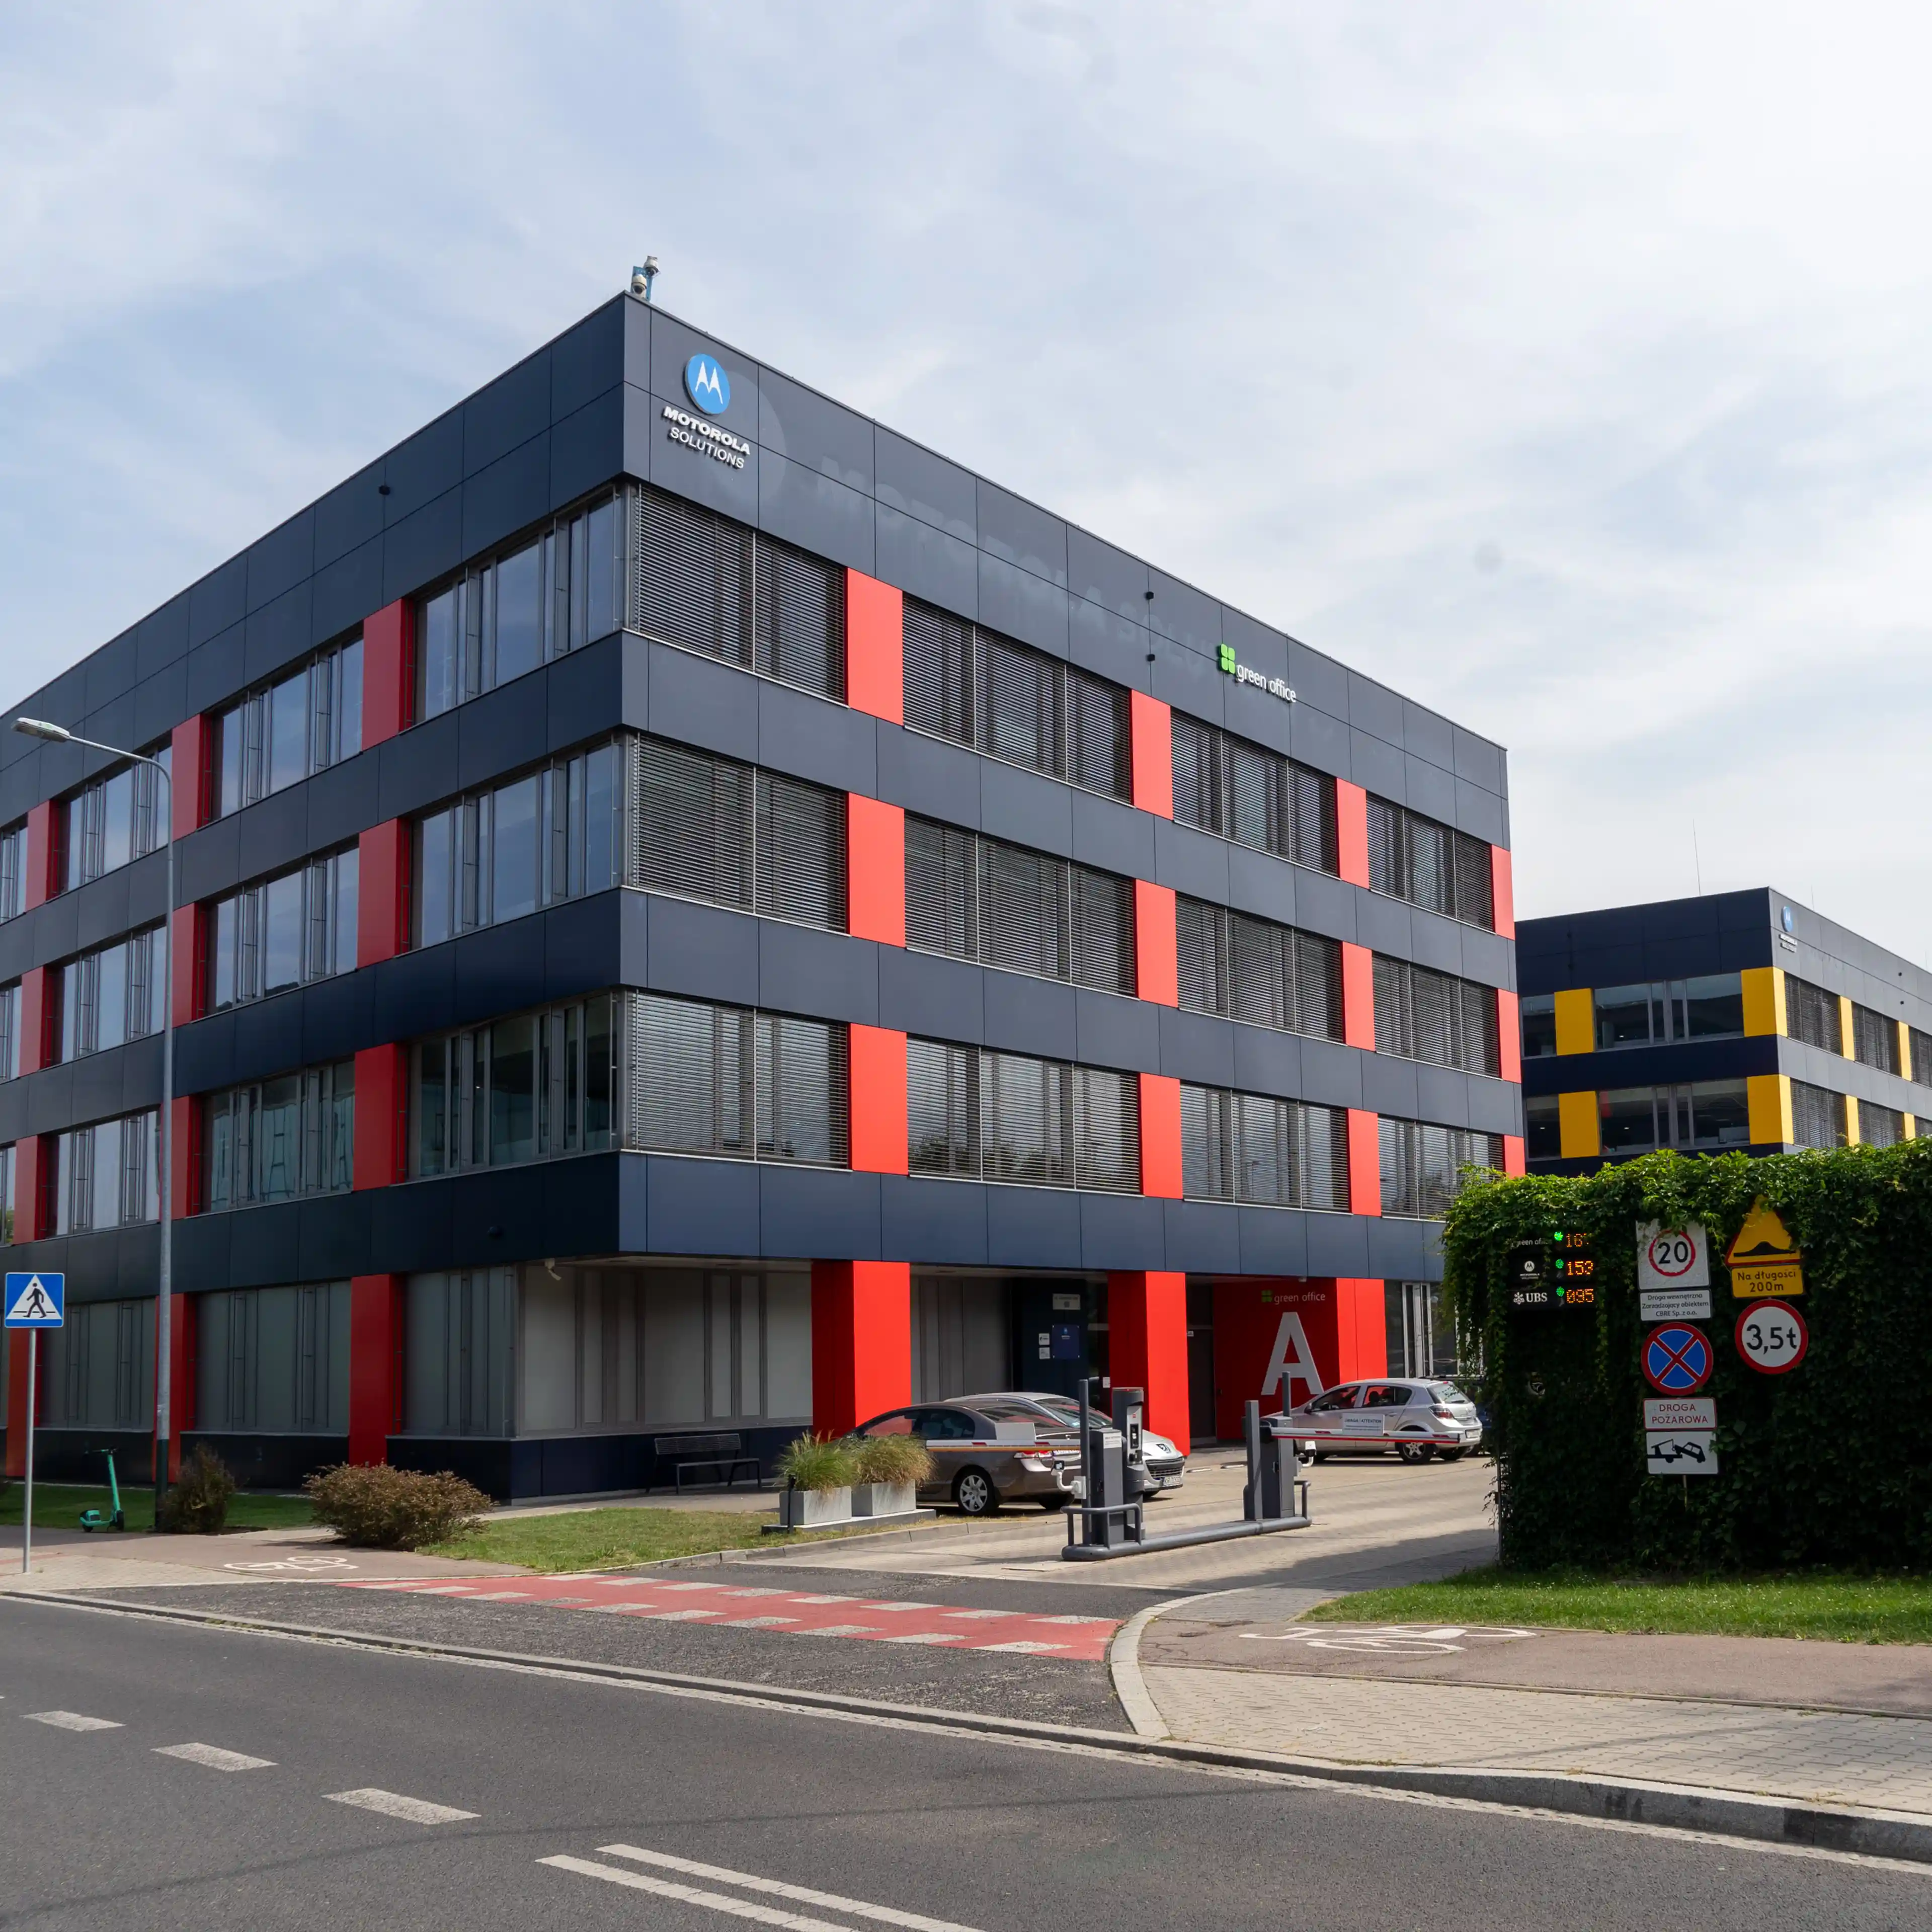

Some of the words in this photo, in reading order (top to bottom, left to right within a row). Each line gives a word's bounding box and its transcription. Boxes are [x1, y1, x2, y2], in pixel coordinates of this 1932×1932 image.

[663, 406, 751, 455] MOTOROLA
[670, 427, 744, 468] SOLUTIONS
[1236, 664, 1267, 689] green
[1268, 678, 1297, 703] office
[1658, 1241, 1688, 1264] 20
[1567, 1260, 1594, 1275] 153
[1737, 1271, 1751, 1281] Na
[1754, 1269, 1796, 1281] długości
[1749, 1281, 1784, 1293] 200m
[1274, 1295, 1299, 1305] green
[1302, 1292, 1326, 1302] office
[1526, 1292, 1548, 1303] UBS
[1566, 1288, 1594, 1303] 095
[1746, 1324, 1797, 1354] 3,5t
[1261, 1312, 1324, 1395] A
[1659, 1403, 1696, 1412] DROGA
[1651, 1413, 1709, 1424] POŻAROWA
